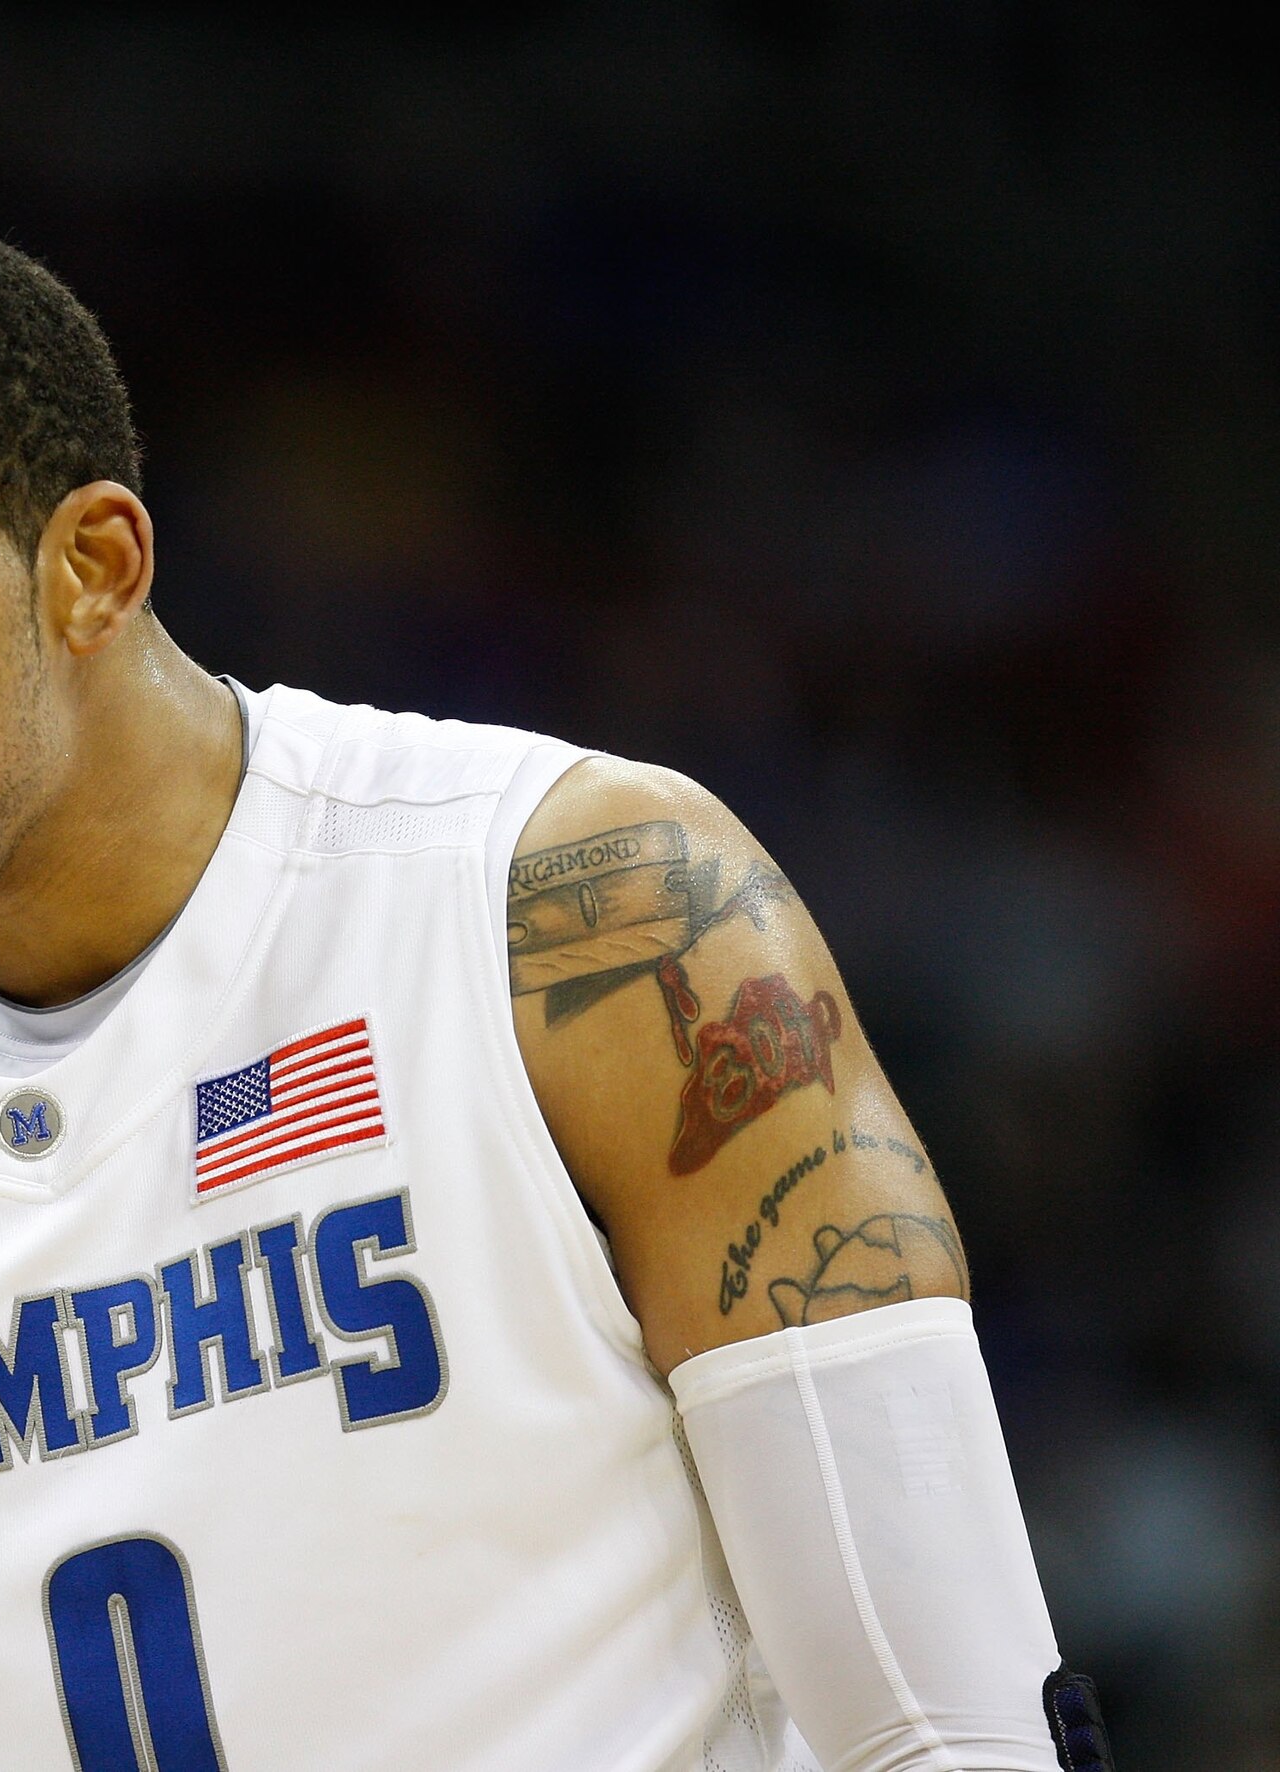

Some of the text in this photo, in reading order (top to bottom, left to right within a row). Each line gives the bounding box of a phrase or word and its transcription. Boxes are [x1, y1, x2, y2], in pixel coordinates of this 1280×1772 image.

[509, 838, 640, 897] RICHMOND
[6, 1101, 52, 1147] M
[720, 1220, 761, 1316] The
[760, 1147, 827, 1228] game
[41, 1530, 230, 1772] 0
